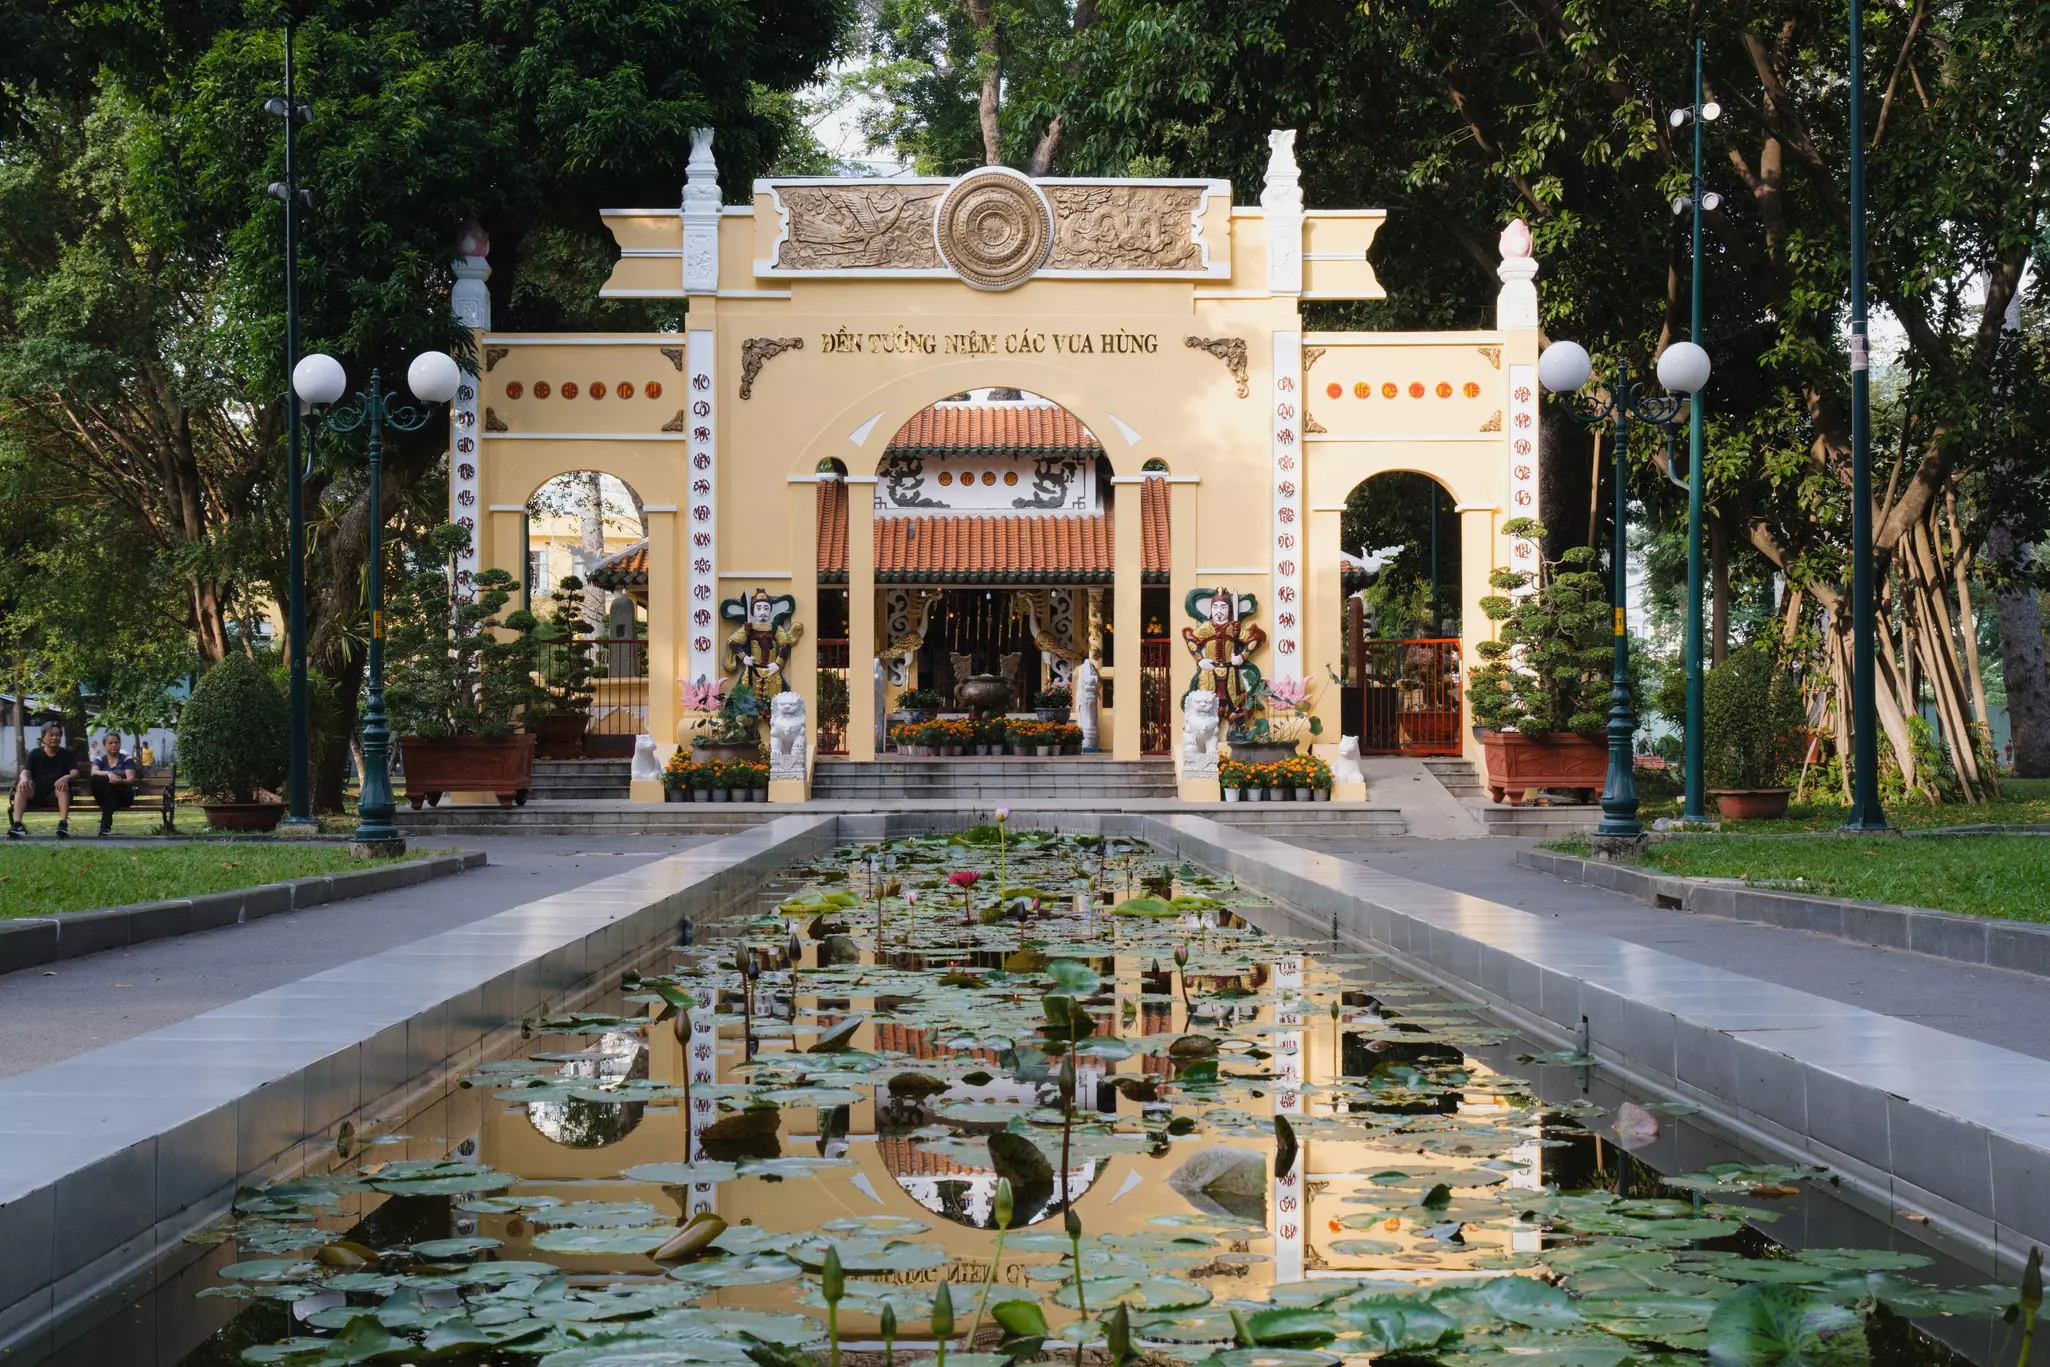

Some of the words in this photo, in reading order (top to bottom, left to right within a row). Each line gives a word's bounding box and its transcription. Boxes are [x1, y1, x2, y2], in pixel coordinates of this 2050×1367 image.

[821, 324, 862, 353] ĐỀN
[944, 329, 998, 358] NIỆM
[1005, 328, 1045, 354] CÁC
[1052, 333, 1094, 354] VUA
[1100, 328, 1158, 354] HÙNG
